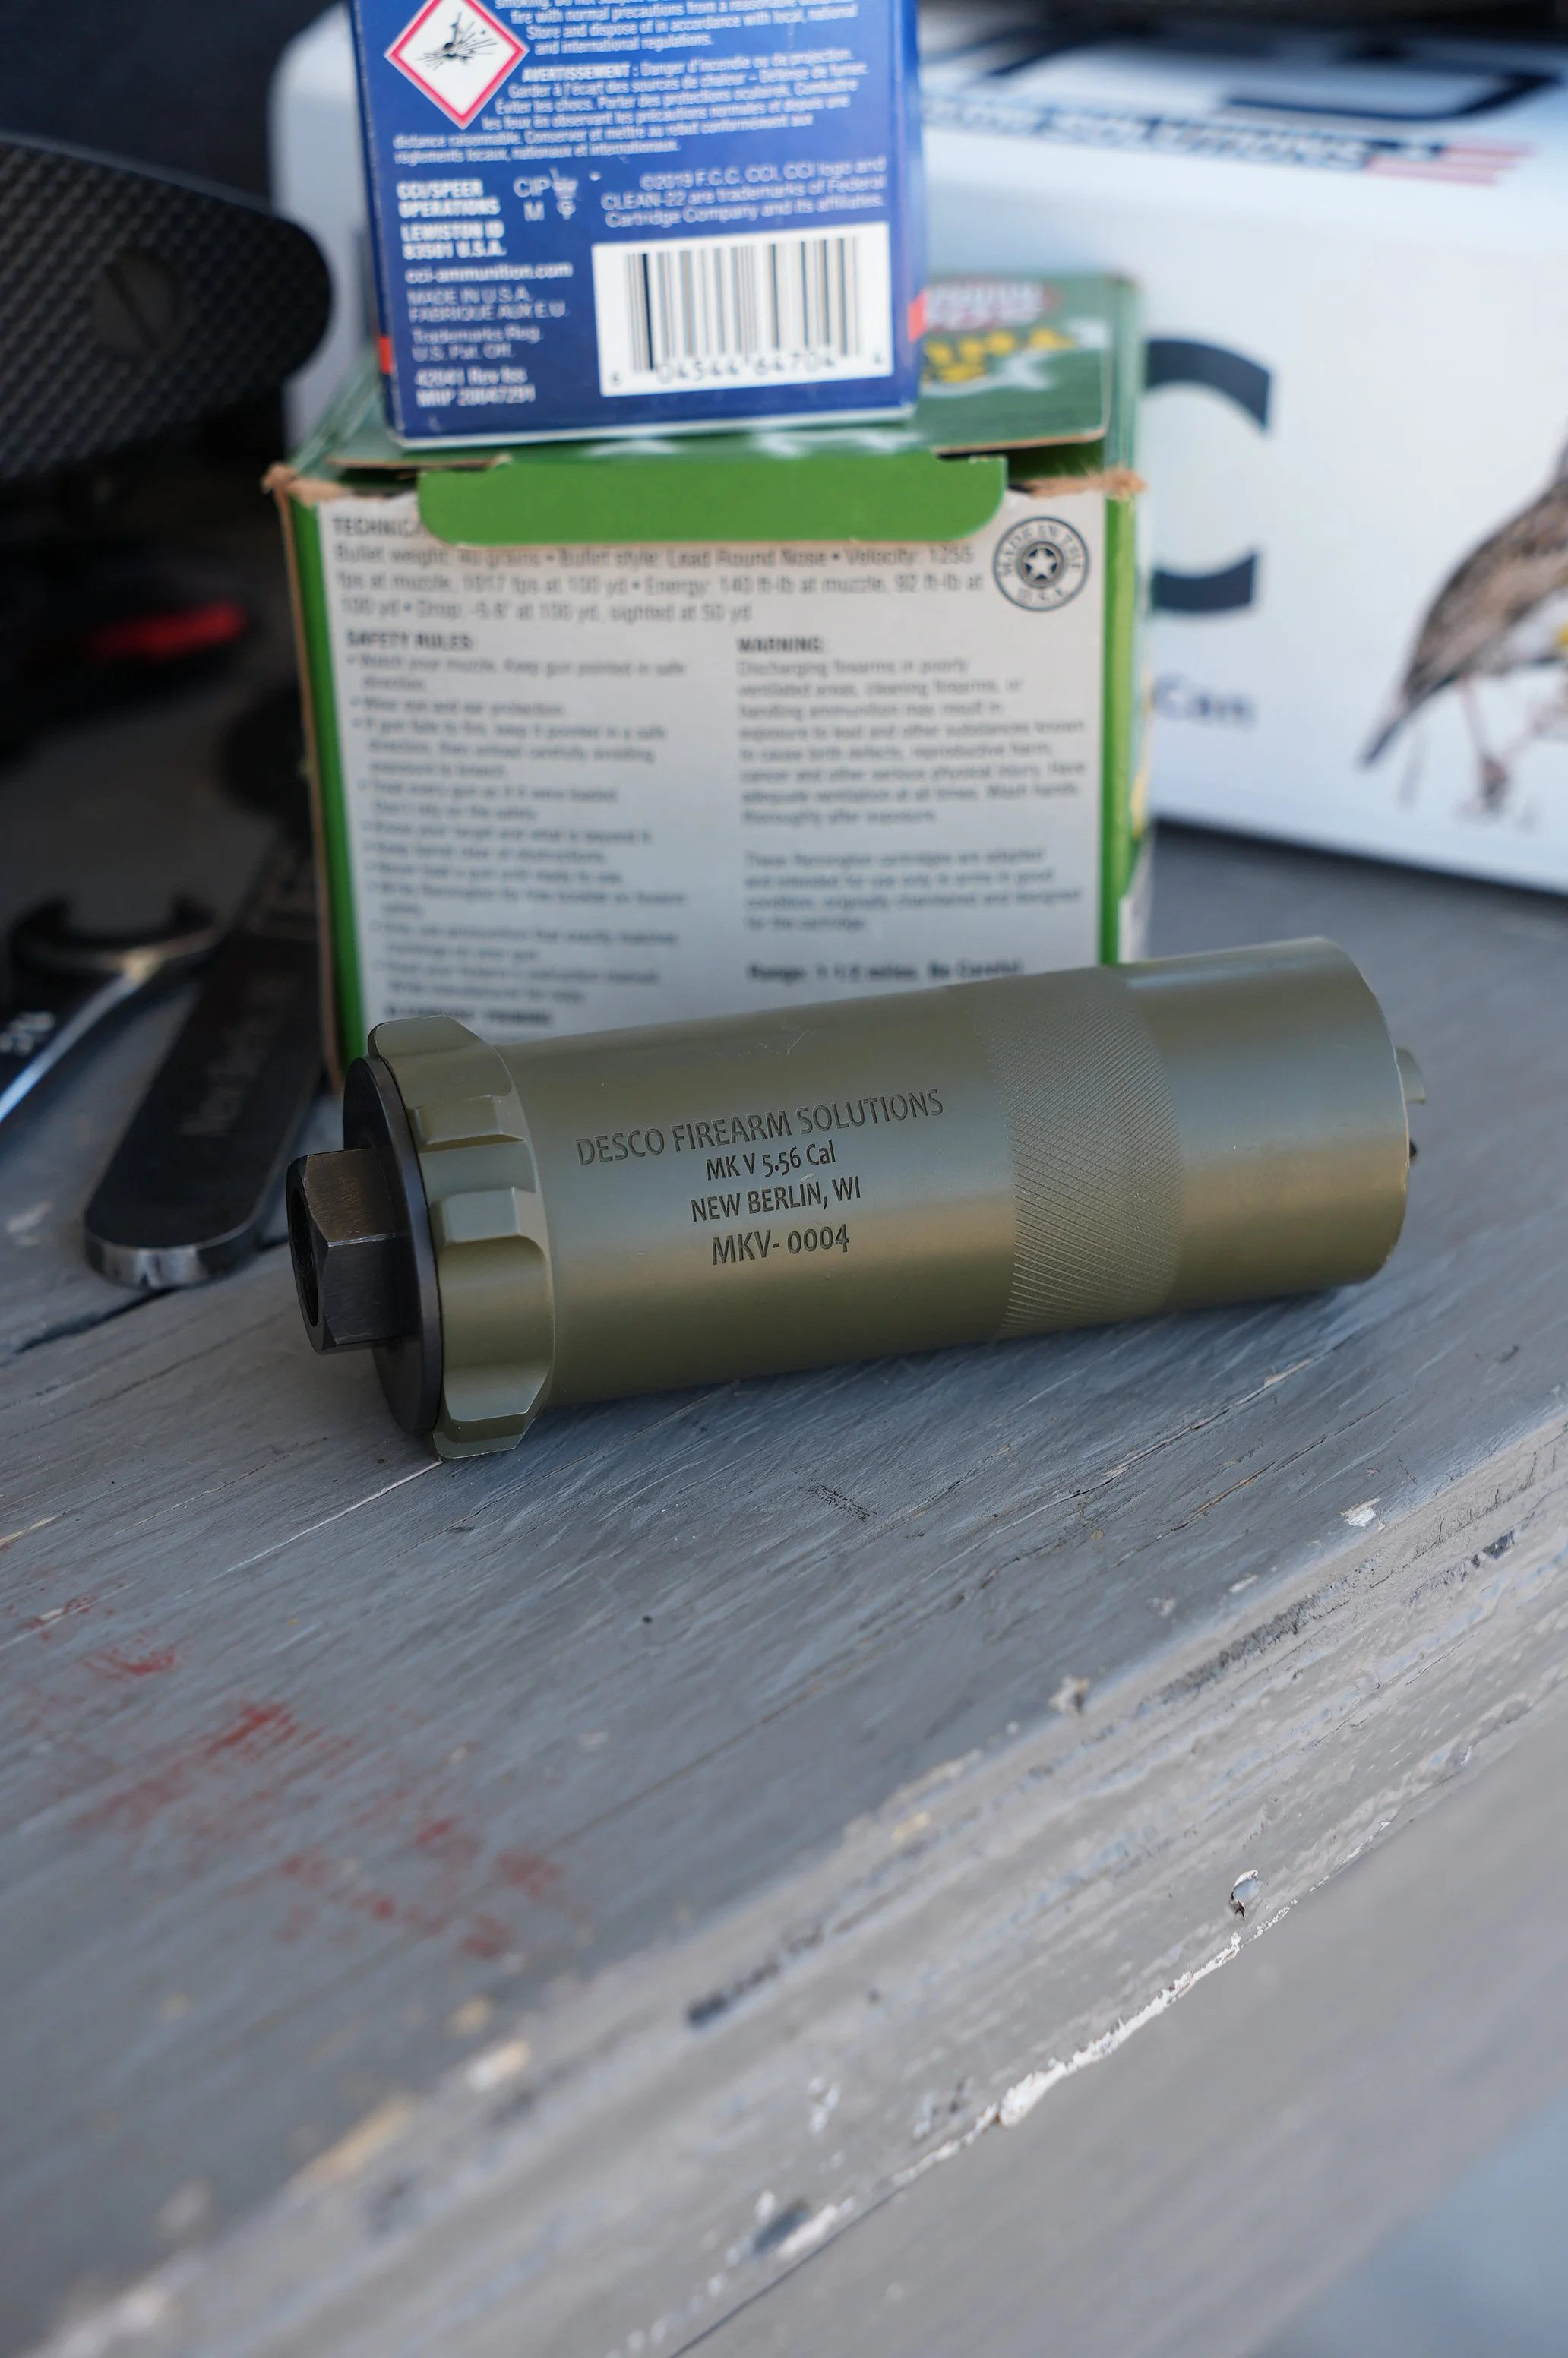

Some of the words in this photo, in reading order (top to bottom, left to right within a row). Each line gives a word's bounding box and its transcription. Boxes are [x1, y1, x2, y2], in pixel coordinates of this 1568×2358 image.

[565, 7, 609, 21] normal
[612, 3, 684, 22] precautions
[526, 24, 561, 40] Store
[563, 24, 587, 38] and
[589, 22, 637, 40] dispose
[640, 19, 653, 33] of
[655, 21, 668, 32] in
[670, 15, 741, 32] accordance
[535, 40, 559, 55] and
[561, 36, 640, 53] international
[641, 33, 713, 52] regulations.
[522, 62, 630, 82] AVERTISSEMENT
[817, 163, 853, 180] logo
[855, 156, 887, 173] and
[601, 190, 686, 210] CLEAN-22
[688, 191, 715, 204] are
[716, 182, 805, 201] trademarks
[808, 179, 825, 194] of
[826, 175, 886, 192] Federal
[399, 197, 500, 217] OPERATIONS
[605, 210, 681, 228] Cartridge
[682, 205, 760, 223] Company
[761, 201, 792, 217] and
[794, 198, 814, 213] its
[401, 222, 484, 242] LEWISTON
[457, 239, 506, 258] U.S.A.
[405, 263, 573, 283] cci-ammunition.com
[407, 289, 457, 305] MADE
[460, 289, 479, 303] IN
[413, 328, 504, 344] Trademarks
[335, 542, 384, 563] Bullet
[558, 545, 609, 565] Bullet
[666, 547, 710, 567] Lead
[716, 548, 776, 568] Round
[781, 548, 826, 565] Nose
[336, 571, 365, 591] fps
[370, 574, 387, 590] at
[511, 576, 539, 596] fps
[545, 577, 561, 594] at
[800, 577, 817, 593] at
[966, 574, 984, 591] at
[517, 603, 534, 621] at
[609, 604, 675, 626] sighted
[679, 605, 697, 622] at
[346, 630, 409, 648] SAFETY
[576, 1127, 665, 1165] DESCO
[671, 1109, 792, 1152] FIREARM
[795, 1088, 944, 1135] SOLUTIONS
[707, 1155, 740, 1181] MK
[741, 1152, 756, 1175] V
[762, 1146, 802, 1178] 5.56
[805, 1139, 836, 1166] Cal
[691, 1193, 741, 1223] NEW
[748, 1182, 829, 1216] BERLIN,
[831, 1175, 861, 1202] WI
[712, 1229, 781, 1266] MKV-
[787, 1224, 850, 1255] 0004
